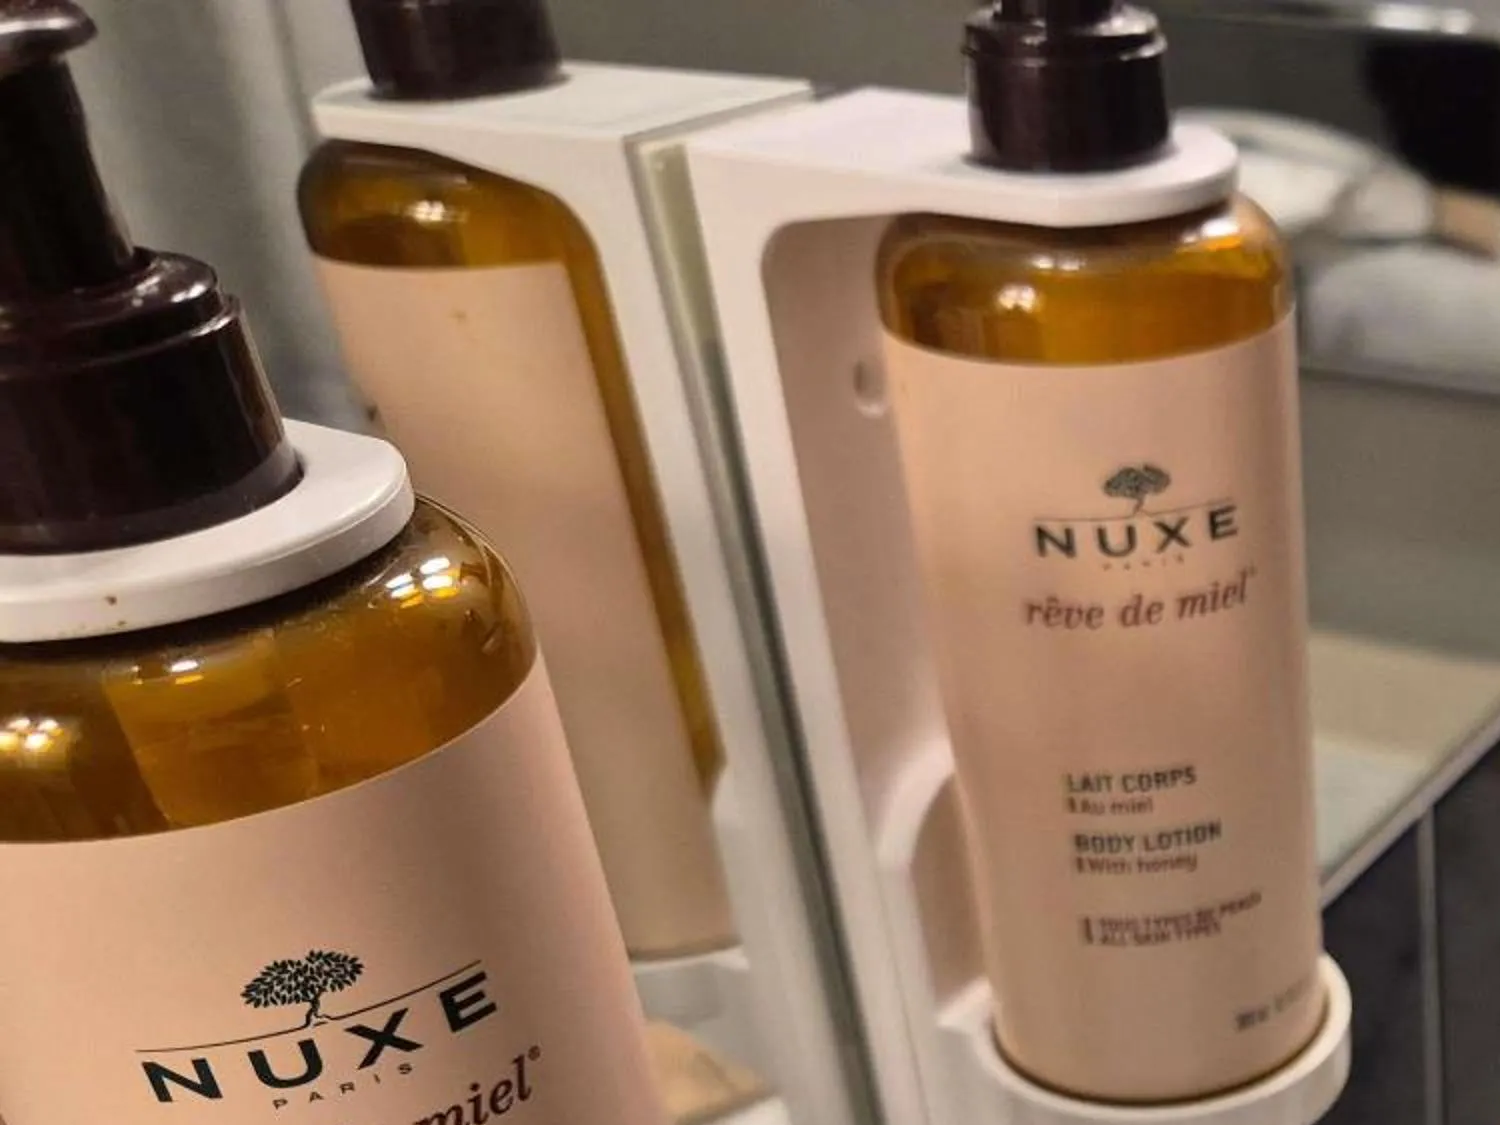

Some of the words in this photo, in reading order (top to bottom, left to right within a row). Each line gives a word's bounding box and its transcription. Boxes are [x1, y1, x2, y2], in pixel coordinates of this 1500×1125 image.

[1034, 504, 1239, 559] NUXE
[1024, 594, 1105, 631] rêve
[1119, 594, 1164, 629] de
[1067, 772, 1113, 794] LAIT
[1121, 765, 1197, 794] CORPS
[1073, 832, 1135, 854] BODY
[1143, 818, 1222, 852] LOTION
[141, 970, 498, 1104] NUXE
[273, 1063, 414, 1110] PARIS
